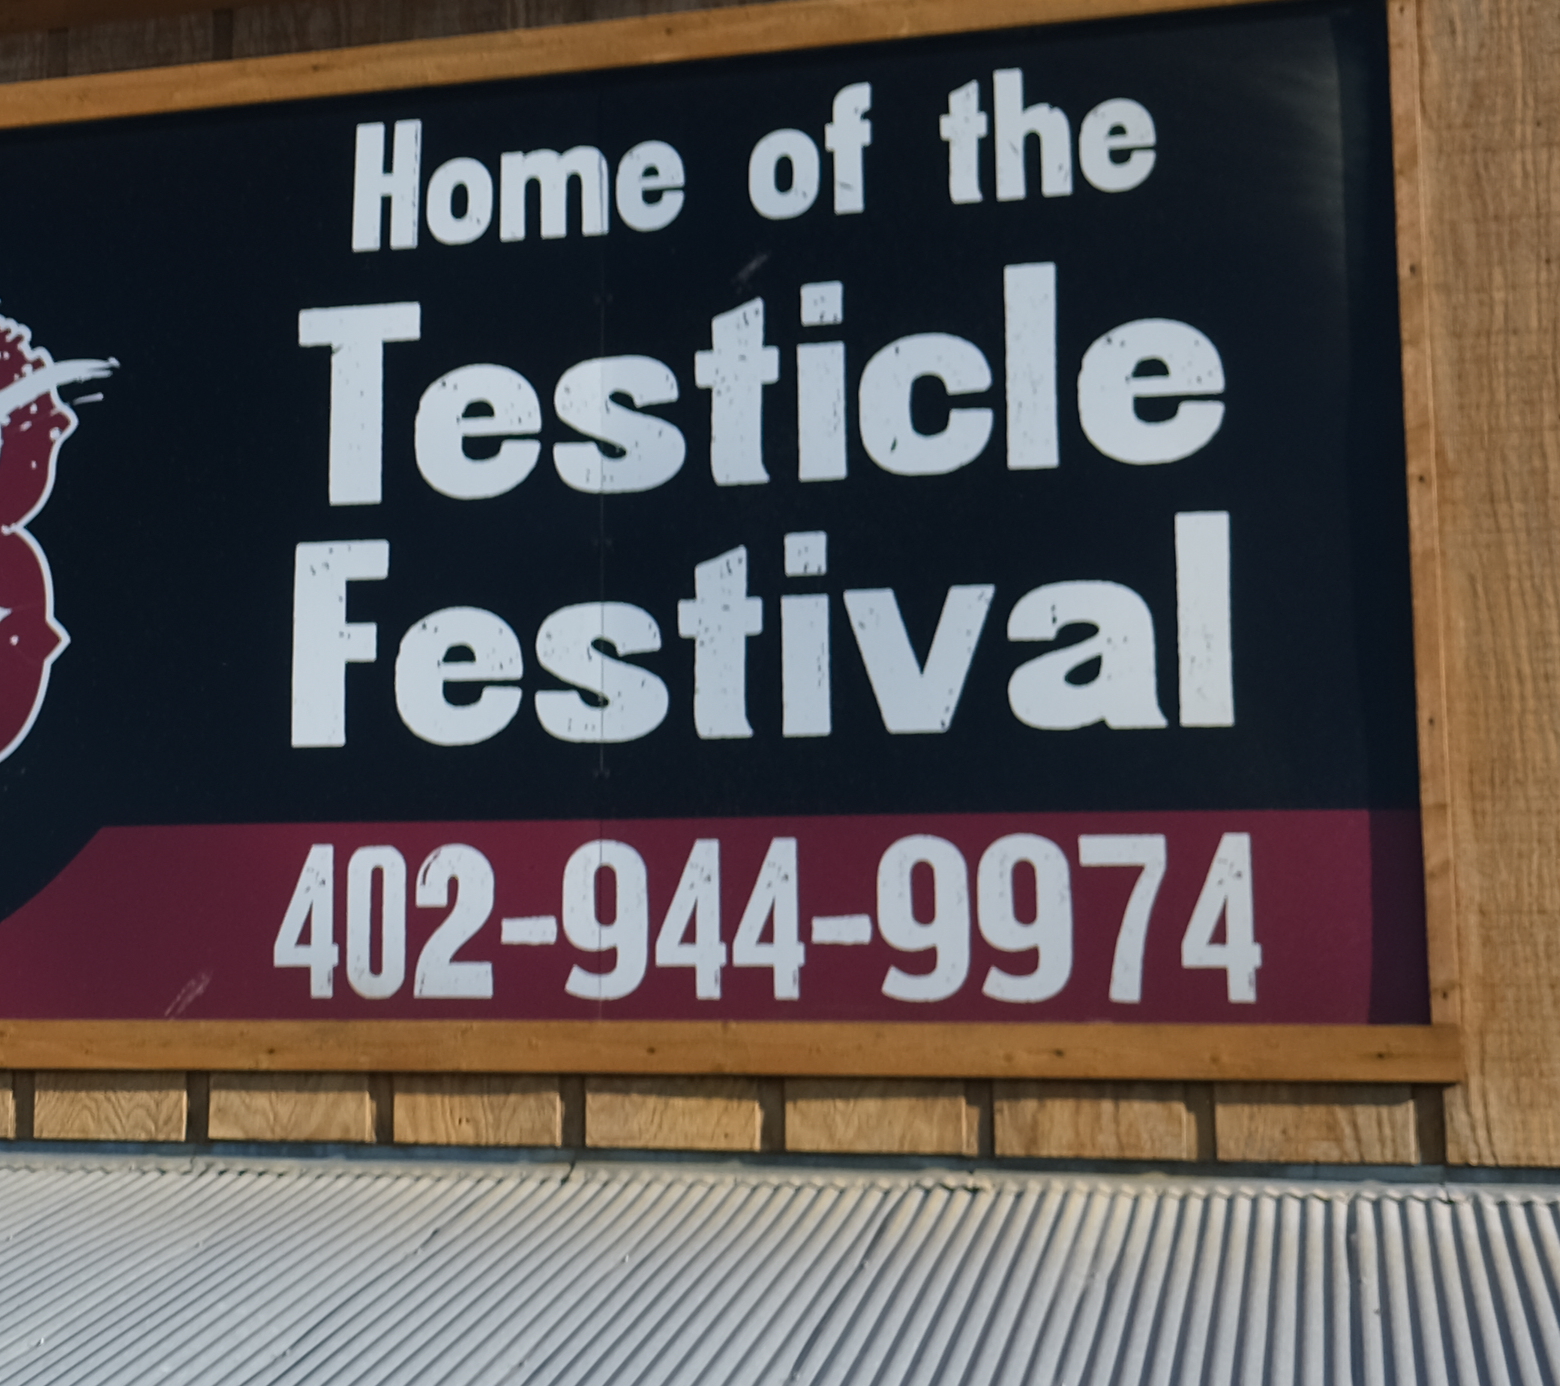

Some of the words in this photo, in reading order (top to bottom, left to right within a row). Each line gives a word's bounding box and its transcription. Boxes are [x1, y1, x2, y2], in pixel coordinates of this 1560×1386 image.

[351, 119, 686, 253] Home
[747, 82, 871, 221] of
[939, 67, 1156, 205] the
[297, 261, 1225, 507] Testicle
[290, 510, 1235, 749] Festival
[273, 831, 1262, 1004] 402-944-9974
